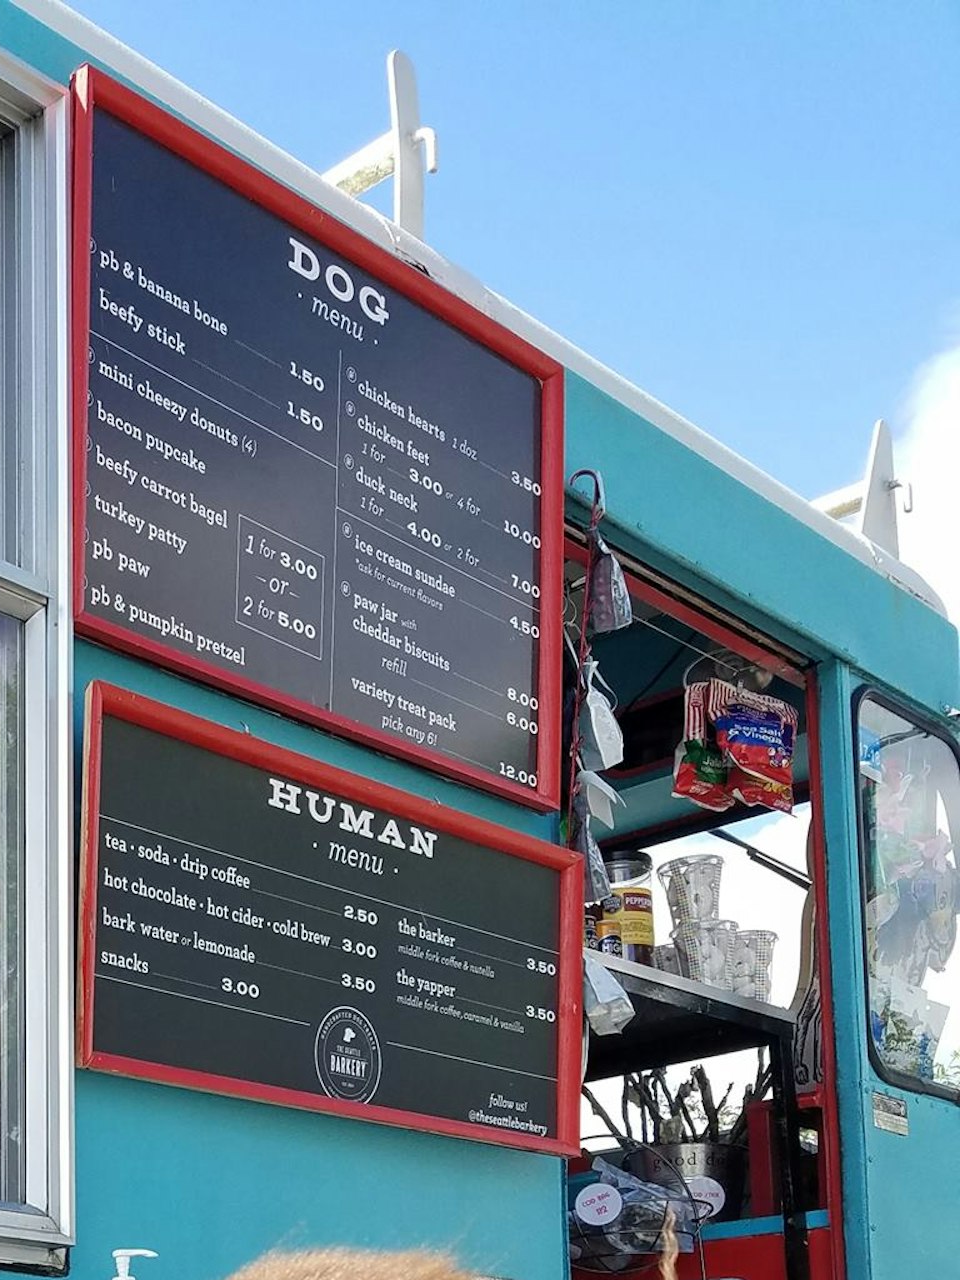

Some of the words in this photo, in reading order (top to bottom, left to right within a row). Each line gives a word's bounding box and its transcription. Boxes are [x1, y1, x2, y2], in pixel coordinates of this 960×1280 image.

[288, 237, 389, 327] DOG
[99, 250, 119, 272] pb
[123, 261, 135, 281] &
[138, 267, 191, 315] banana
[193, 300, 228, 336] bone
[290, 361, 325, 392] 1.50
[311, 296, 364, 342] menu
[99, 288, 143, 334] beefy
[147, 321, 186, 356] stick
[287, 401, 324, 432] 1.50
[97, 400, 142, 442] bacon
[145, 431, 207, 475] pupcake
[98, 360, 134, 391] mini
[136, 380, 188, 422] cheezy
[190, 407, 240, 447] donuts
[241, 435, 258, 458] (4)
[357, 380, 406, 419] chicken
[408, 405, 446, 442] hearts
[460, 441, 478, 461] doz
[511, 470, 542, 497] 3.50
[357, 415, 405, 451] chicken
[407, 442, 430, 467] feet
[95, 444, 138, 486] beefy
[140, 474, 187, 509] carrot
[189, 492, 229, 529] bagel
[356, 466, 386, 496] duck
[389, 487, 419, 513] neck
[370, 446, 386, 464] for
[409, 467, 443, 496] 3.00
[456, 497, 464, 510] 4
[465, 497, 481, 517] for
[504, 520, 541, 550] 10.00
[92, 538, 113, 561] pb
[118, 551, 151, 578] paw
[94, 493, 146, 534] turkey
[148, 521, 188, 555] patty
[245, 535, 255, 555] 1
[259, 539, 276, 560] for
[279, 551, 318, 580] 3.00
[368, 499, 385, 518] for
[406, 521, 441, 548] 4.00
[456, 547, 465, 560] 2
[465, 548, 480, 568] for
[510, 573, 541, 599] 7.00
[269, 577, 290, 595] or
[353, 593, 379, 614] paw
[380, 602, 399, 623] jar
[355, 534, 374, 557] ice
[376, 549, 413, 577] cream
[414, 568, 456, 598] sundae
[509, 615, 540, 639] 4.50
[374, 567, 386, 582] for
[386, 576, 417, 598] current
[91, 584, 111, 606] pb
[114, 594, 126, 613] &
[129, 603, 194, 644] pumpkin
[196, 633, 246, 666] pretzel
[242, 596, 253, 616] 2
[257, 599, 275, 621] for
[277, 611, 316, 640] 5.00
[353, 615, 402, 650] cheddar
[404, 636, 450, 672] biscuits
[507, 687, 539, 711] 8.00
[381, 656, 408, 678] refill
[506, 711, 539, 735] 6.00
[351, 677, 395, 708] variety
[397, 694, 427, 719] treat
[428, 710, 457, 733] pack
[381, 714, 404, 734] pick
[406, 727, 425, 746] any
[499, 762, 538, 788] 12.00
[268, 777, 438, 859] HUMAN
[104, 832, 128, 853] tea
[137, 844, 170, 866] soda
[180, 853, 209, 880] drip
[211, 866, 251, 890] coffee
[343, 905, 379, 926] 2.50
[328, 841, 384, 875] menu
[104, 867, 129, 892] hot
[131, 877, 197, 911] chocolate
[206, 896, 230, 920] hot
[231, 907, 265, 930] cider
[272, 919, 299, 939] cold
[300, 923, 331, 948] brew
[341, 938, 378, 959] 3.00
[100, 950, 150, 974] snacks
[221, 977, 260, 999] 3.00
[102, 906, 136, 933] bark
[140, 922, 180, 944] water
[180, 936, 192, 947] or
[193, 930, 256, 964] lemonade
[341, 973, 376, 994] 3.50
[397, 944, 425, 960] middle
[424, 949, 440, 963] fork
[440, 956, 463, 970] coffee
[398, 918, 417, 937] the
[418, 922, 457, 948] barker
[526, 958, 557, 977] 3.50
[396, 968, 416, 987] the
[416, 976, 457, 998] yapper
[525, 1005, 556, 1023] 3.50
[396, 994, 424, 1009] middle
[424, 999, 440, 1013] fork
[488, 1092, 514, 1110] follow
[515, 1101, 529, 1113] us!
